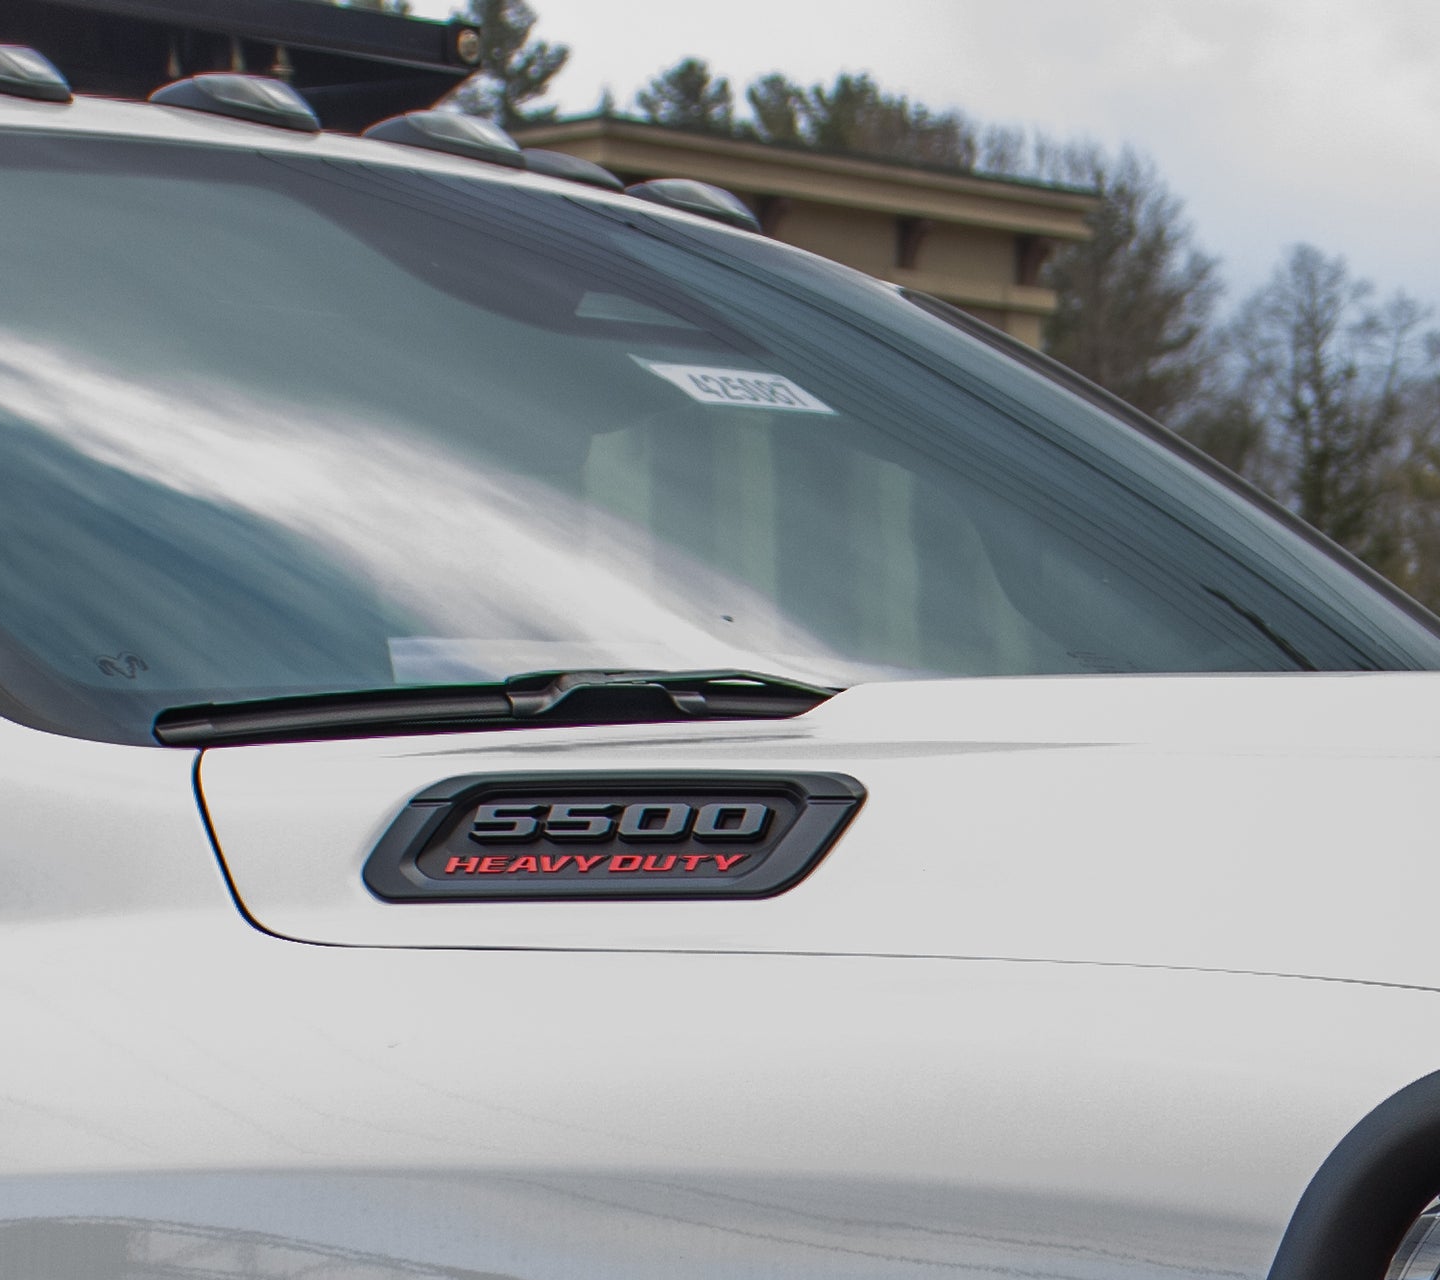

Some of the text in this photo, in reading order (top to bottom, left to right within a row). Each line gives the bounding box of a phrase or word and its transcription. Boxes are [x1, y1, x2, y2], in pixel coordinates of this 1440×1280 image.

[468, 803, 777, 845] 5500
[444, 852, 749, 875] HEAVY DUTY
